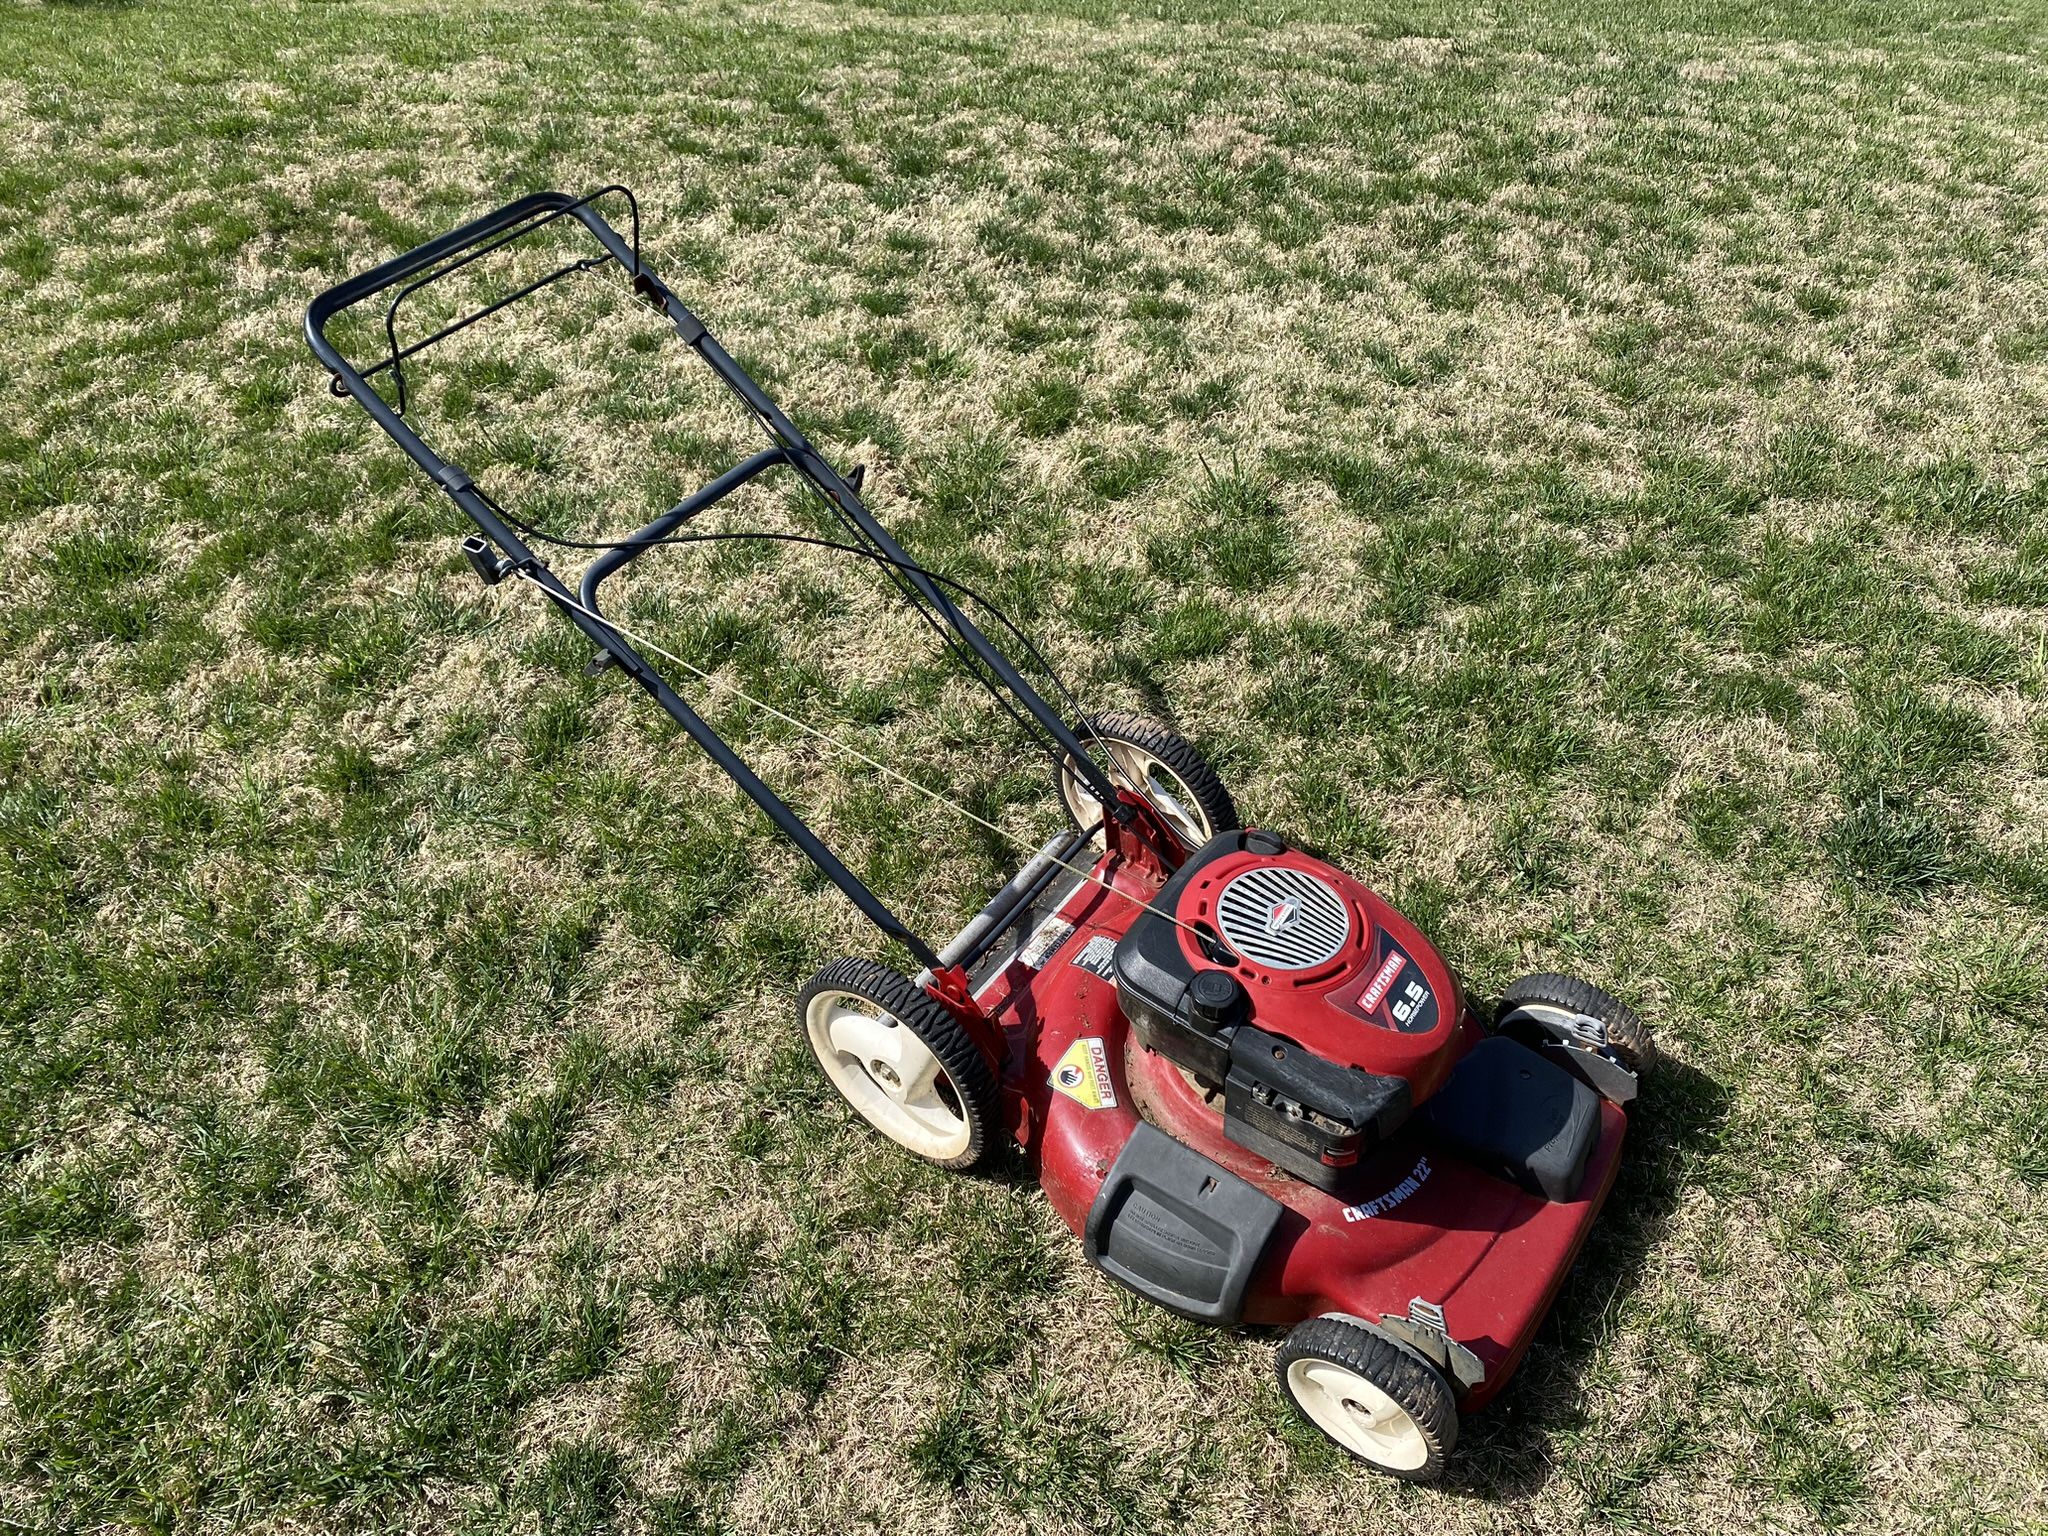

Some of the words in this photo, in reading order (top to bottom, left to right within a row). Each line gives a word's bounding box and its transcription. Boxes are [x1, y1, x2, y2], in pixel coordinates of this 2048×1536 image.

[1361, 953, 1403, 1009] CRAFTSMAN
[1392, 980, 1424, 1021] 6.5
[1405, 990, 1430, 1027] HORSEPOWER
[1091, 1047, 1112, 1099] DANGER
[1342, 1175, 1421, 1223] CRAFTSMAN
[1413, 1156, 1432, 1182] 22"
